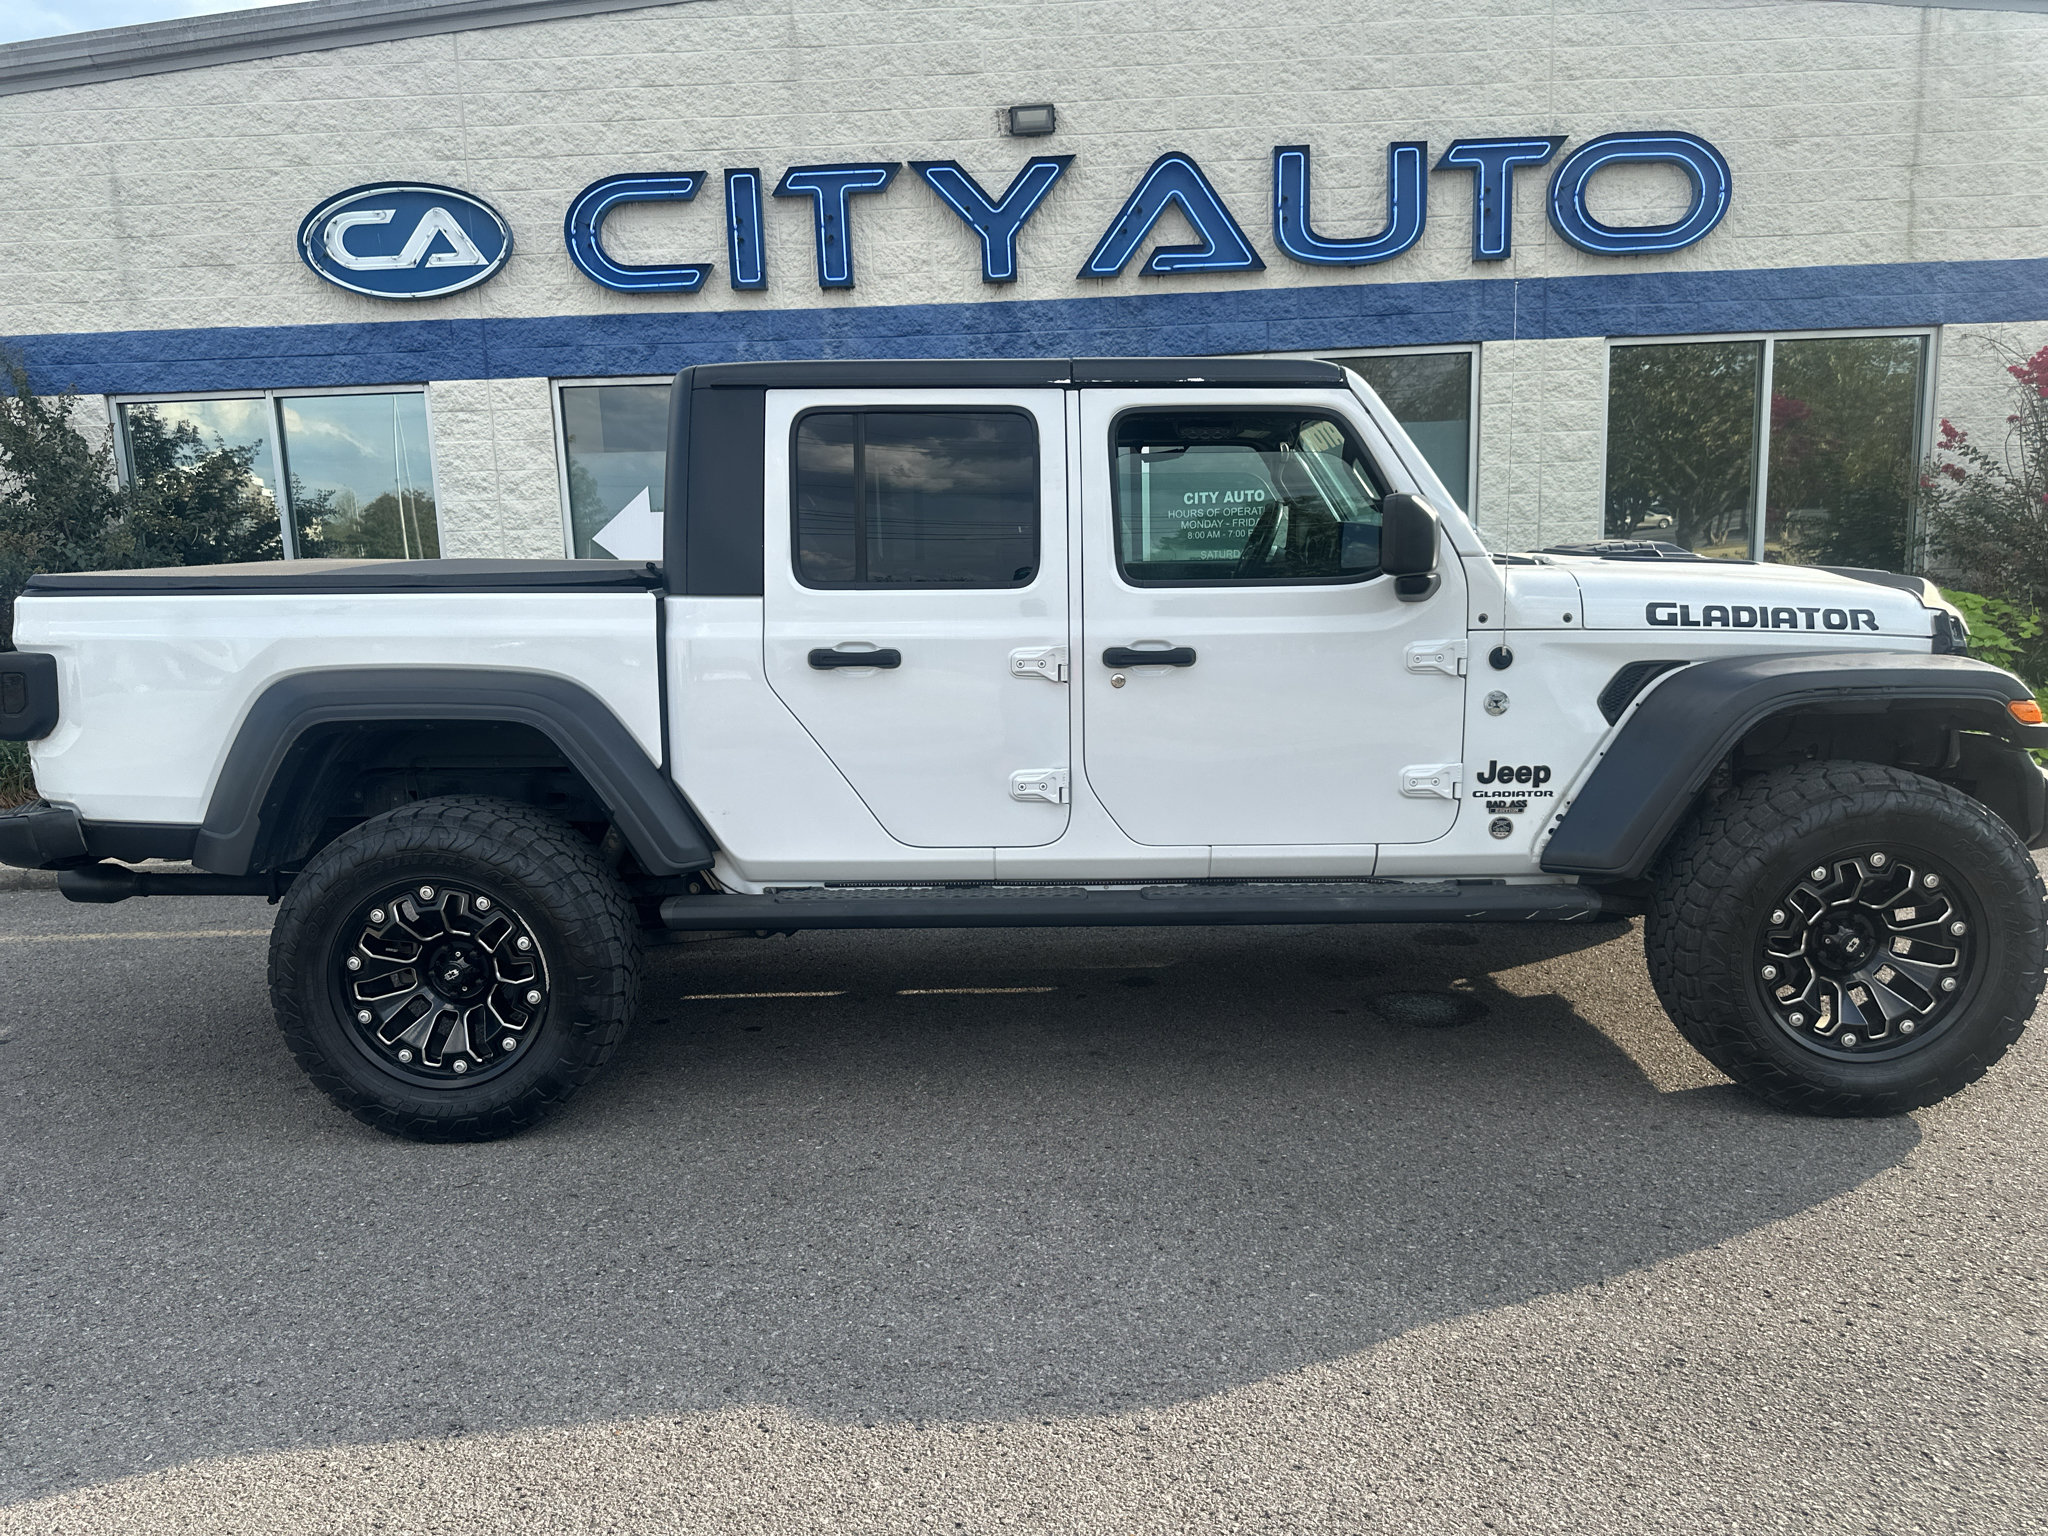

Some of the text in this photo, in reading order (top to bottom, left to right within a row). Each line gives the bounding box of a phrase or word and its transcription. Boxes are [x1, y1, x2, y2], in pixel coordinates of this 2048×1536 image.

[564, 131, 1733, 293] CITY AUTO
[323, 207, 489, 271] CA
[1183, 489, 1265, 505] CITY AUTO
[1168, 509, 1204, 519] HOURS
[1206, 508, 1221, 518] OF
[1180, 519, 1225, 530] MONDAY
[1187, 531, 1206, 540] 8:00
[1207, 530, 1221, 540] AM
[1228, 529, 1246, 539] 7:00
[1200, 549, 1244, 561] SATURD
[1645, 601, 1880, 632] GLADIATOR
[1477, 760, 1552, 788] Jeep
[1472, 790, 1554, 798] GLADIATOR
[1486, 799, 1528, 808] BAD ASS
